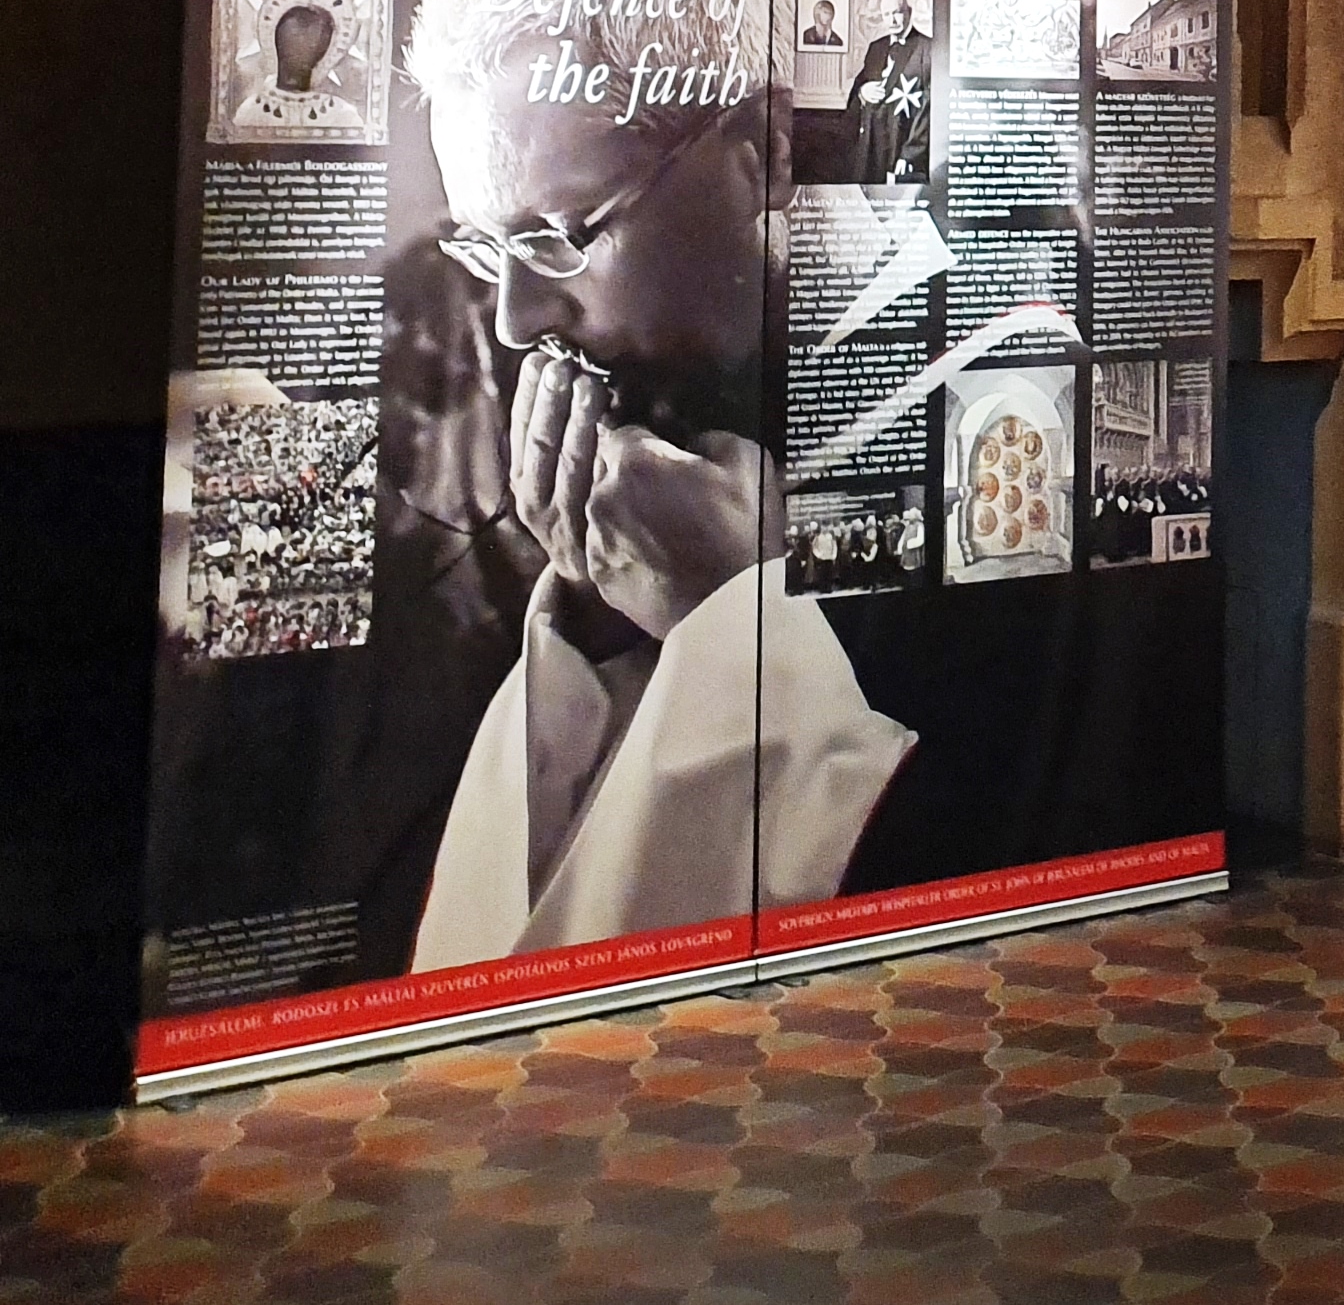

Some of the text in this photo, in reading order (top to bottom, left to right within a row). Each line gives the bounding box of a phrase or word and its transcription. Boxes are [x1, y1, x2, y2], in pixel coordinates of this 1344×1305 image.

[527, 41, 749, 125] the faith
[574, 950, 614, 972] SZENT
